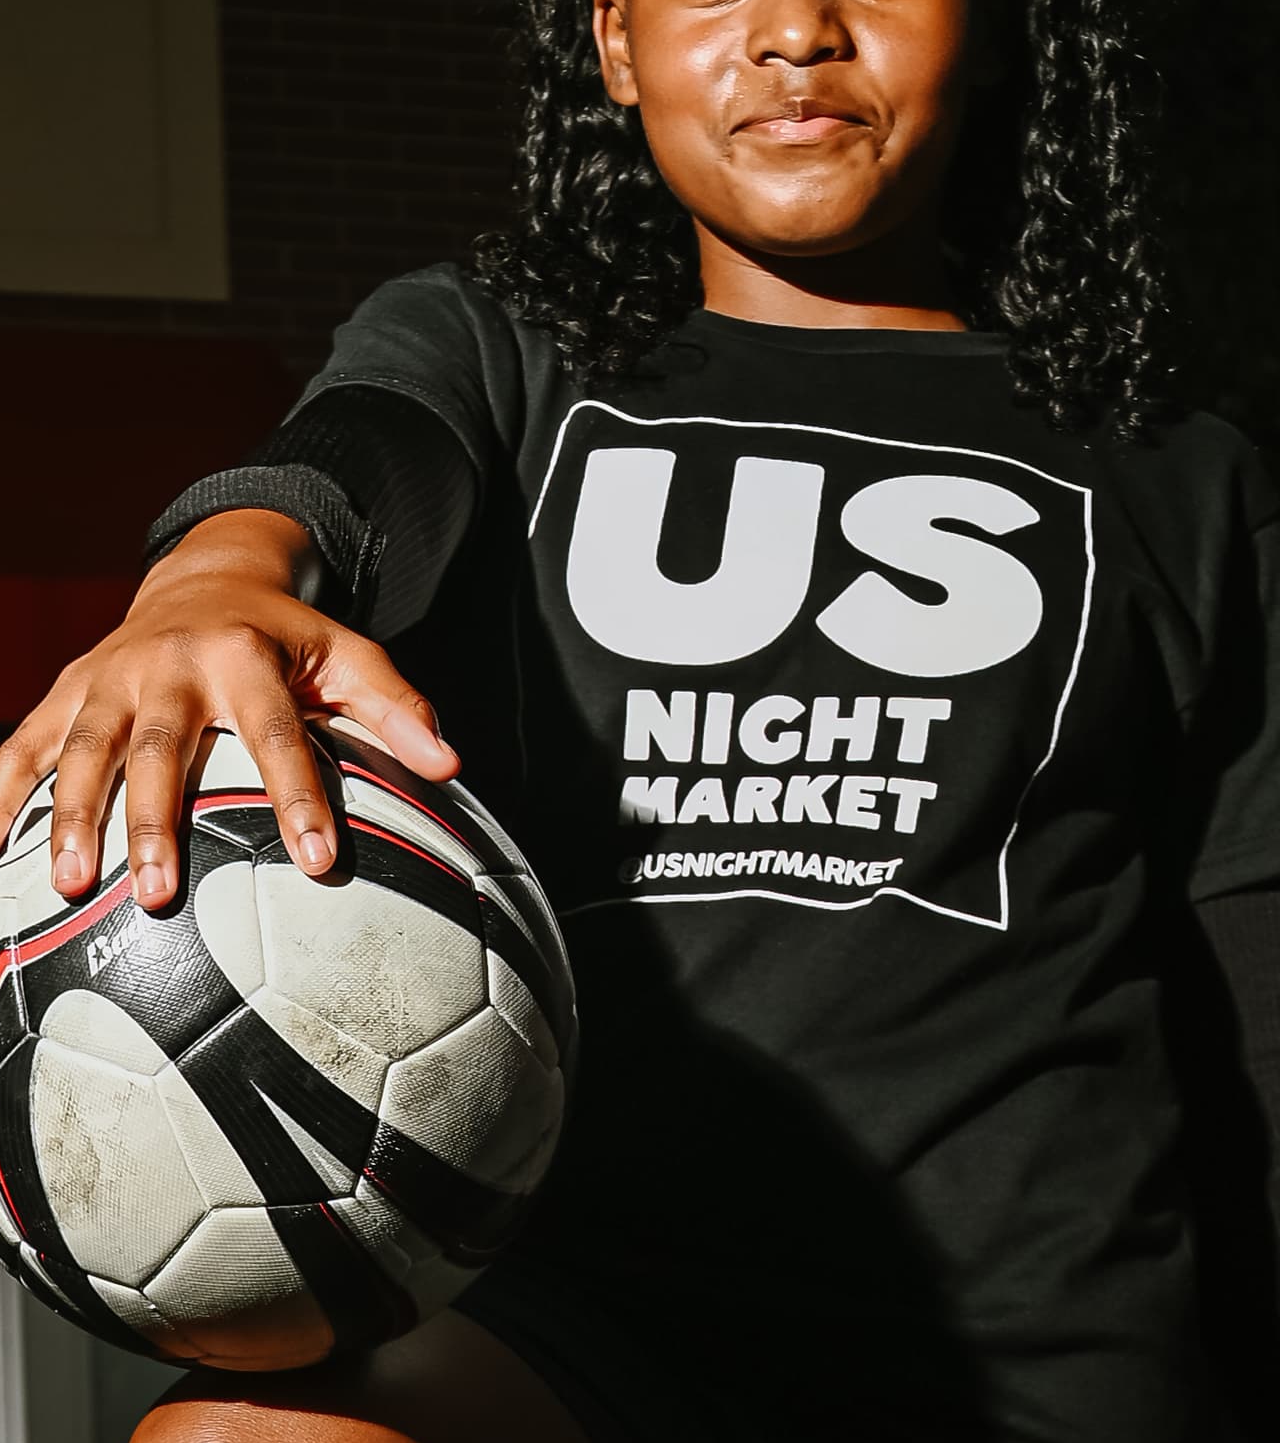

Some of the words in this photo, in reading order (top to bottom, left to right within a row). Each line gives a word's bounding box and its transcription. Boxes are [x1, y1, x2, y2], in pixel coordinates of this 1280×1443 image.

[565, 446, 1044, 678] US
[622, 687, 953, 765] NIGHT
[620, 774, 938, 835] MARKET
